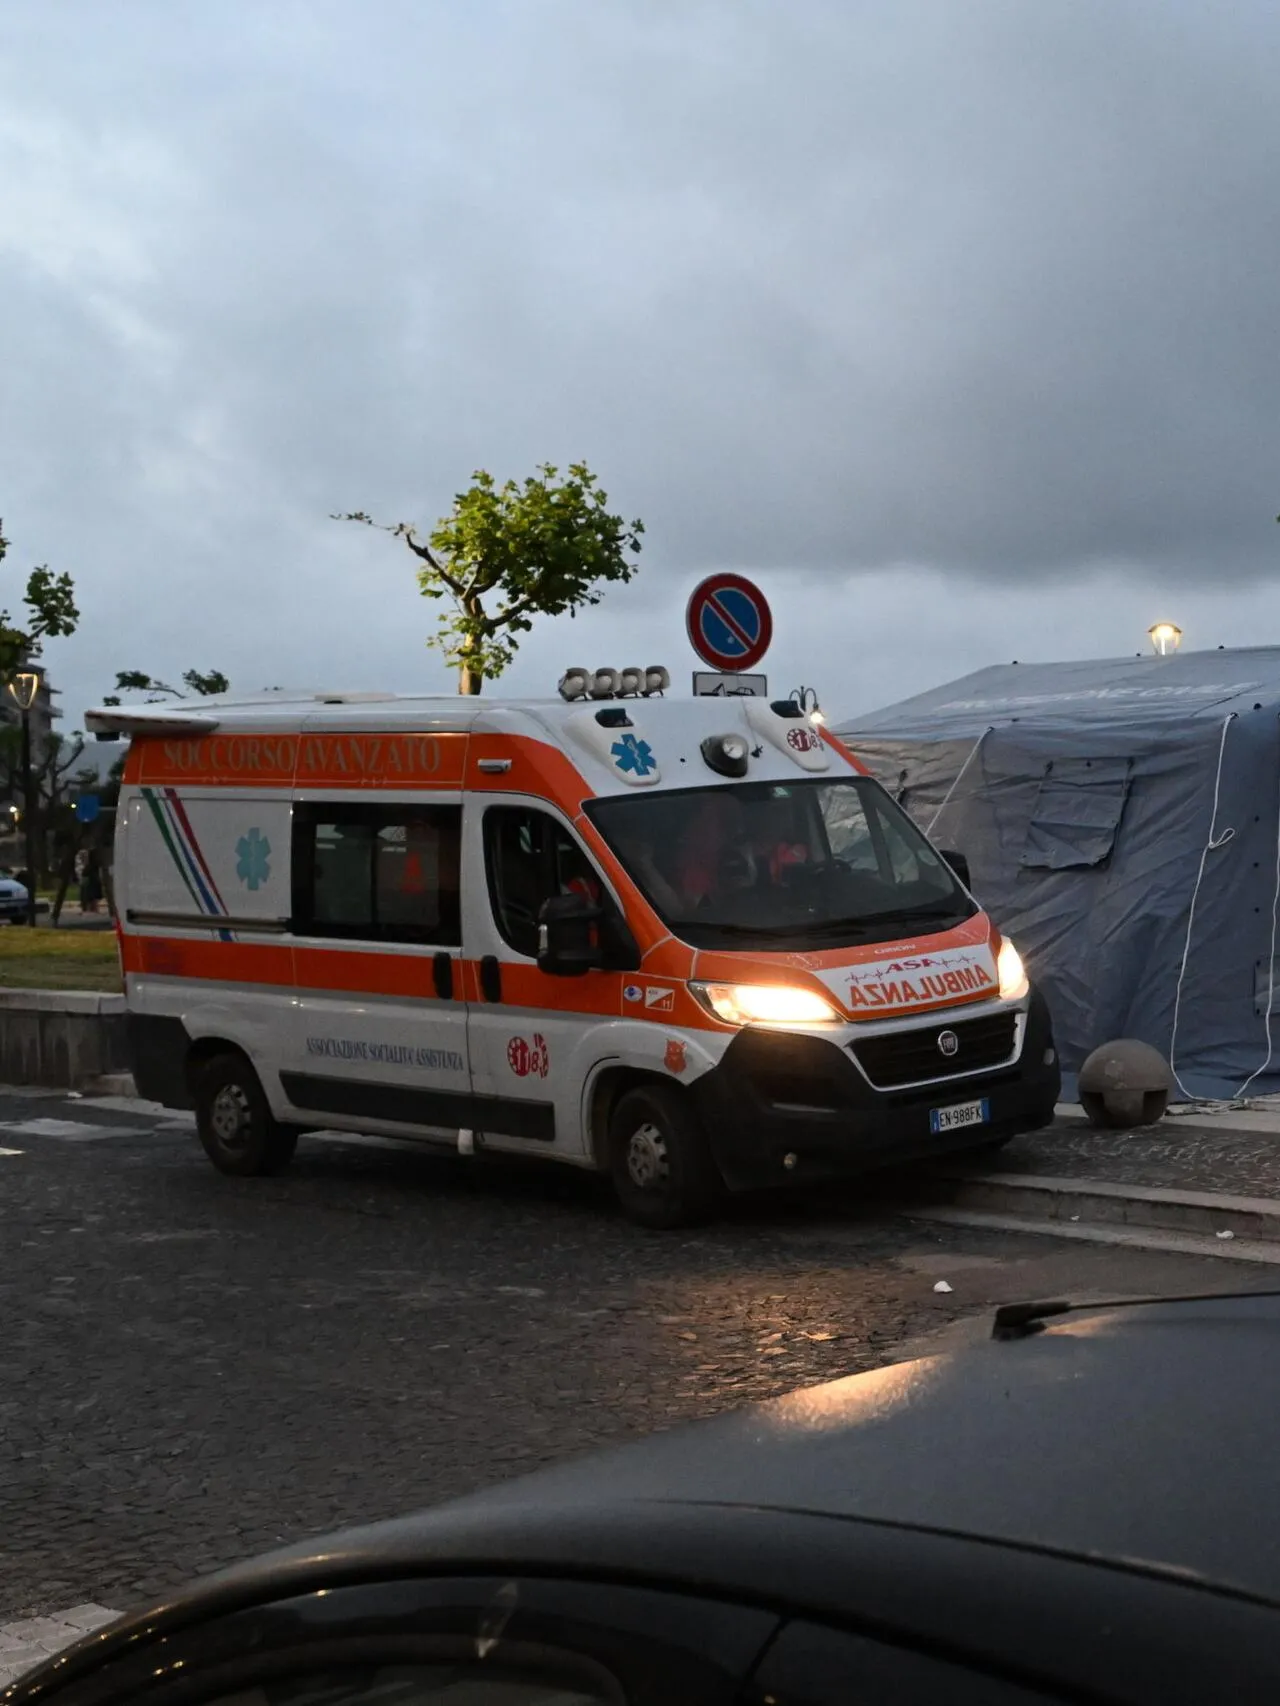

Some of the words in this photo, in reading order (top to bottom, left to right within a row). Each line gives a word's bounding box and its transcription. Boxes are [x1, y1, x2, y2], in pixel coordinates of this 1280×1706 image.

[163, 736, 294, 770] SOCCORSO
[303, 735, 441, 773] AVANZATO
[886, 958, 936, 974] ASA
